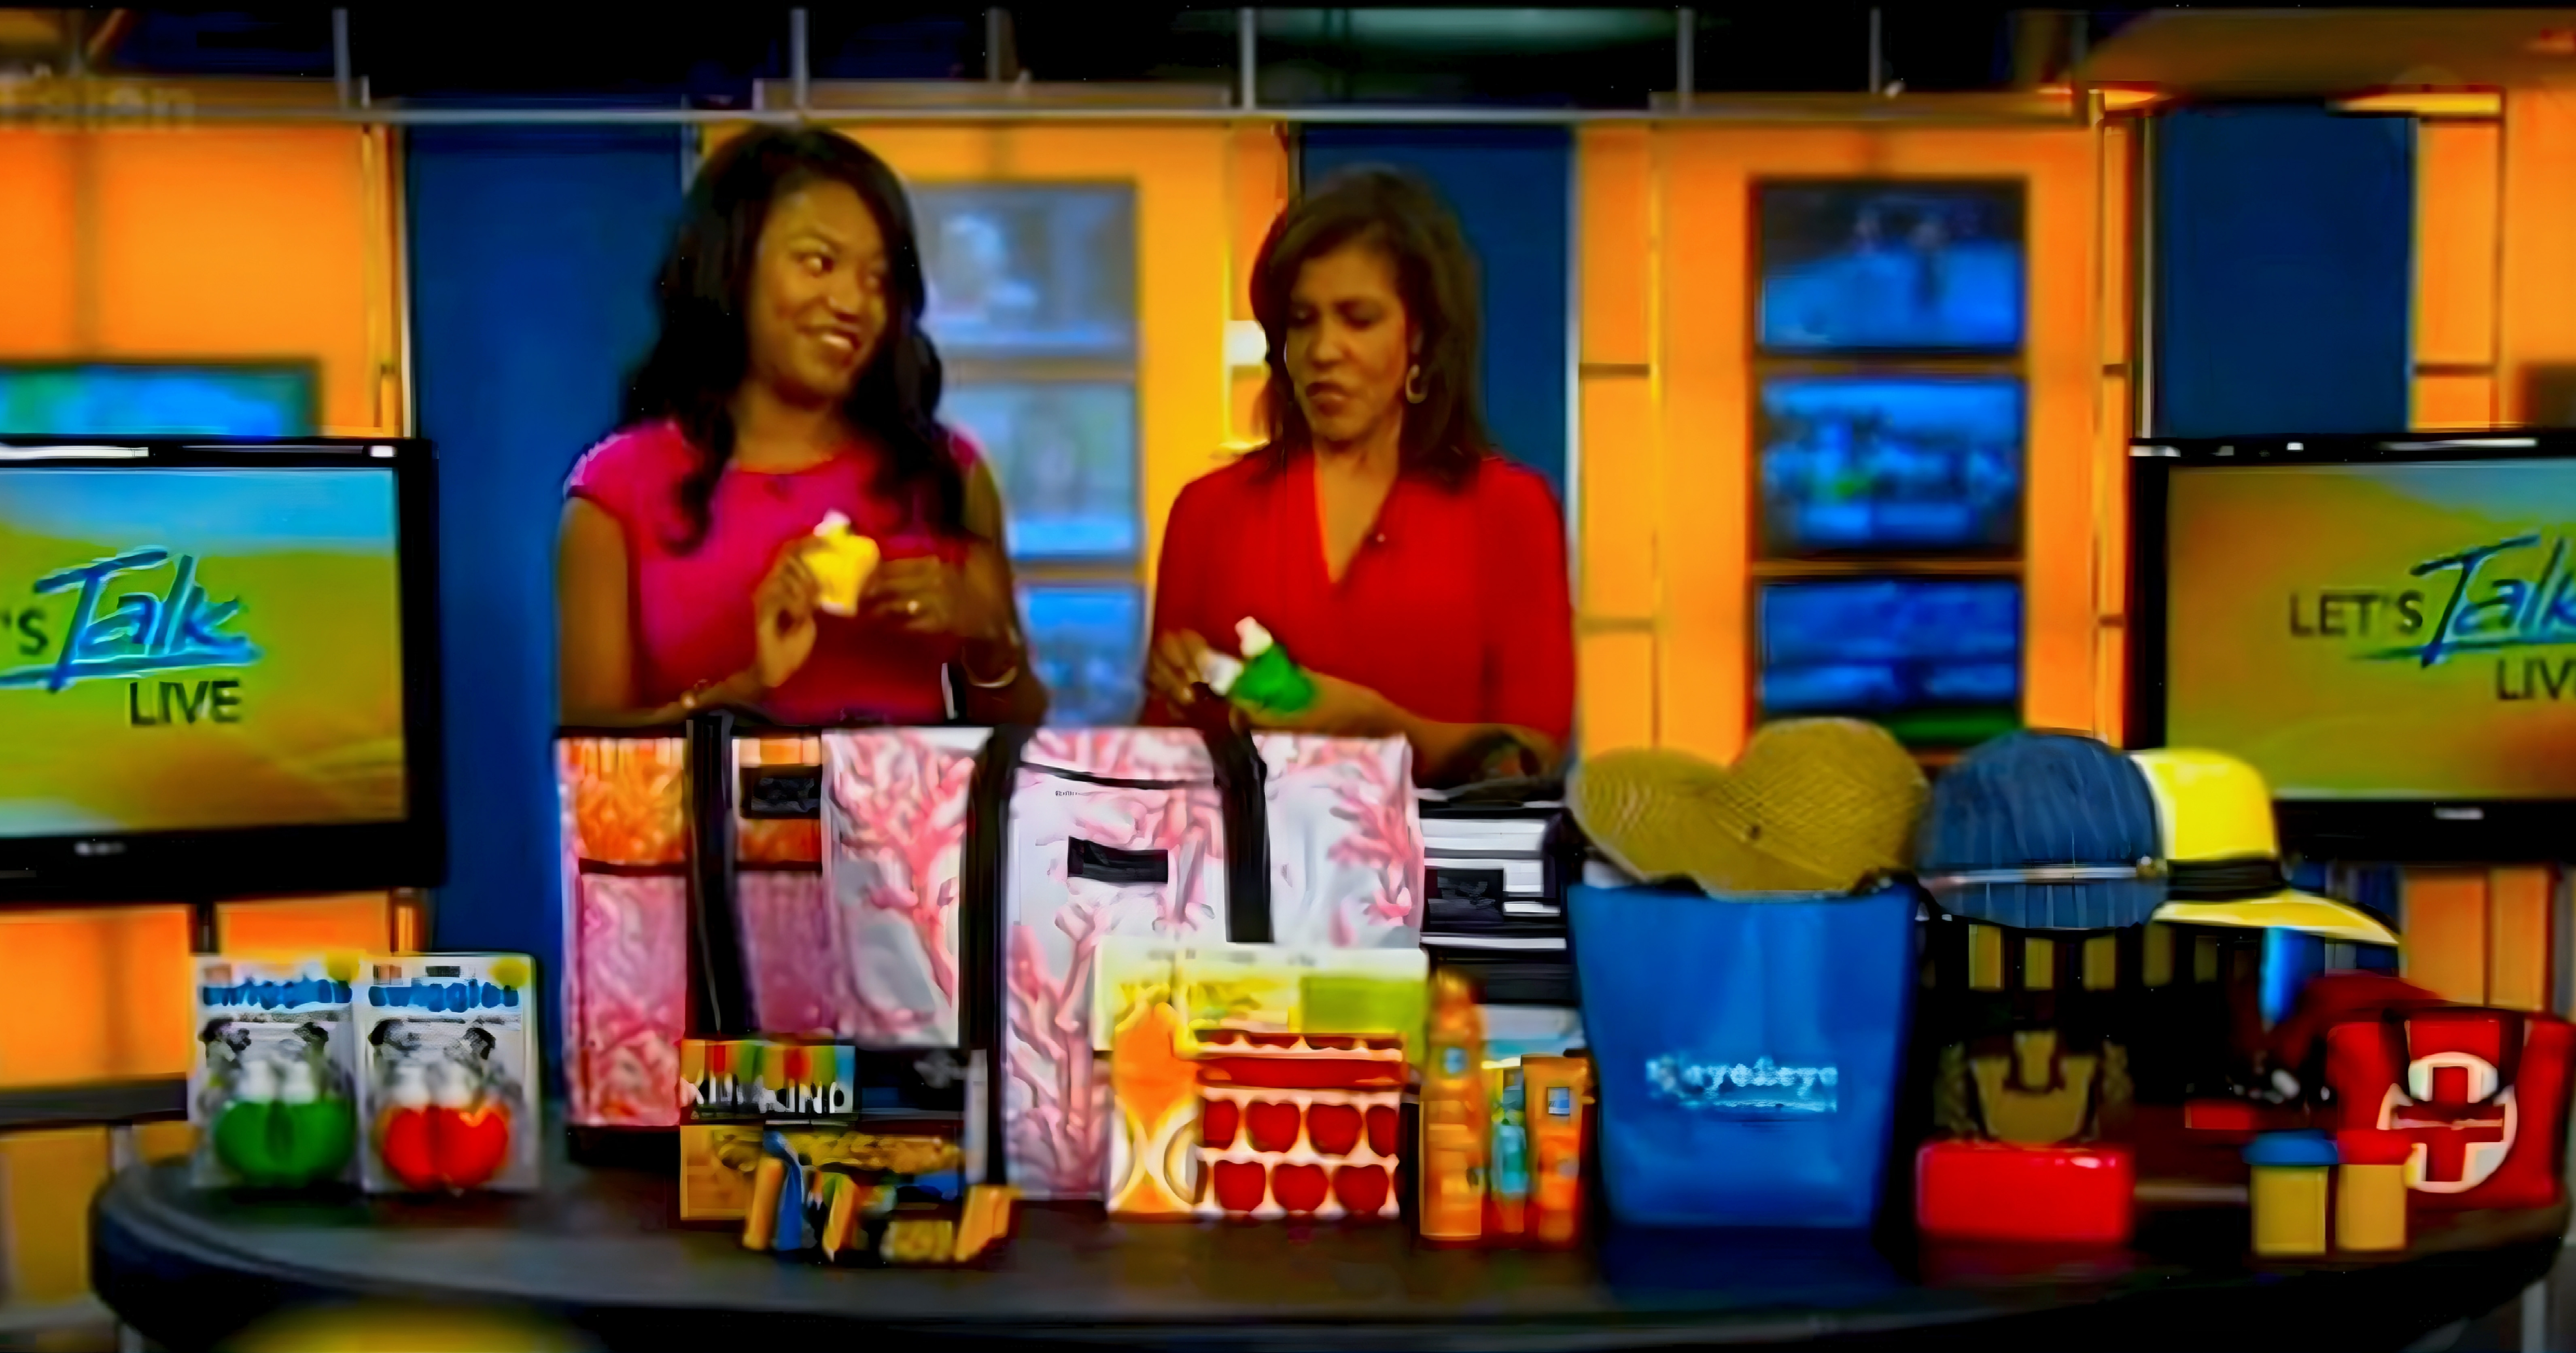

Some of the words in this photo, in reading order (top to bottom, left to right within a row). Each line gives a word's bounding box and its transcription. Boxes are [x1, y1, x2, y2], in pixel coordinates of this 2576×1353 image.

[33, 545, 263, 693] Talk
[2289, 591, 2425, 636] LET'S
[2497, 657, 2576, 701] LIV
[129, 679, 242, 727] LIVE
